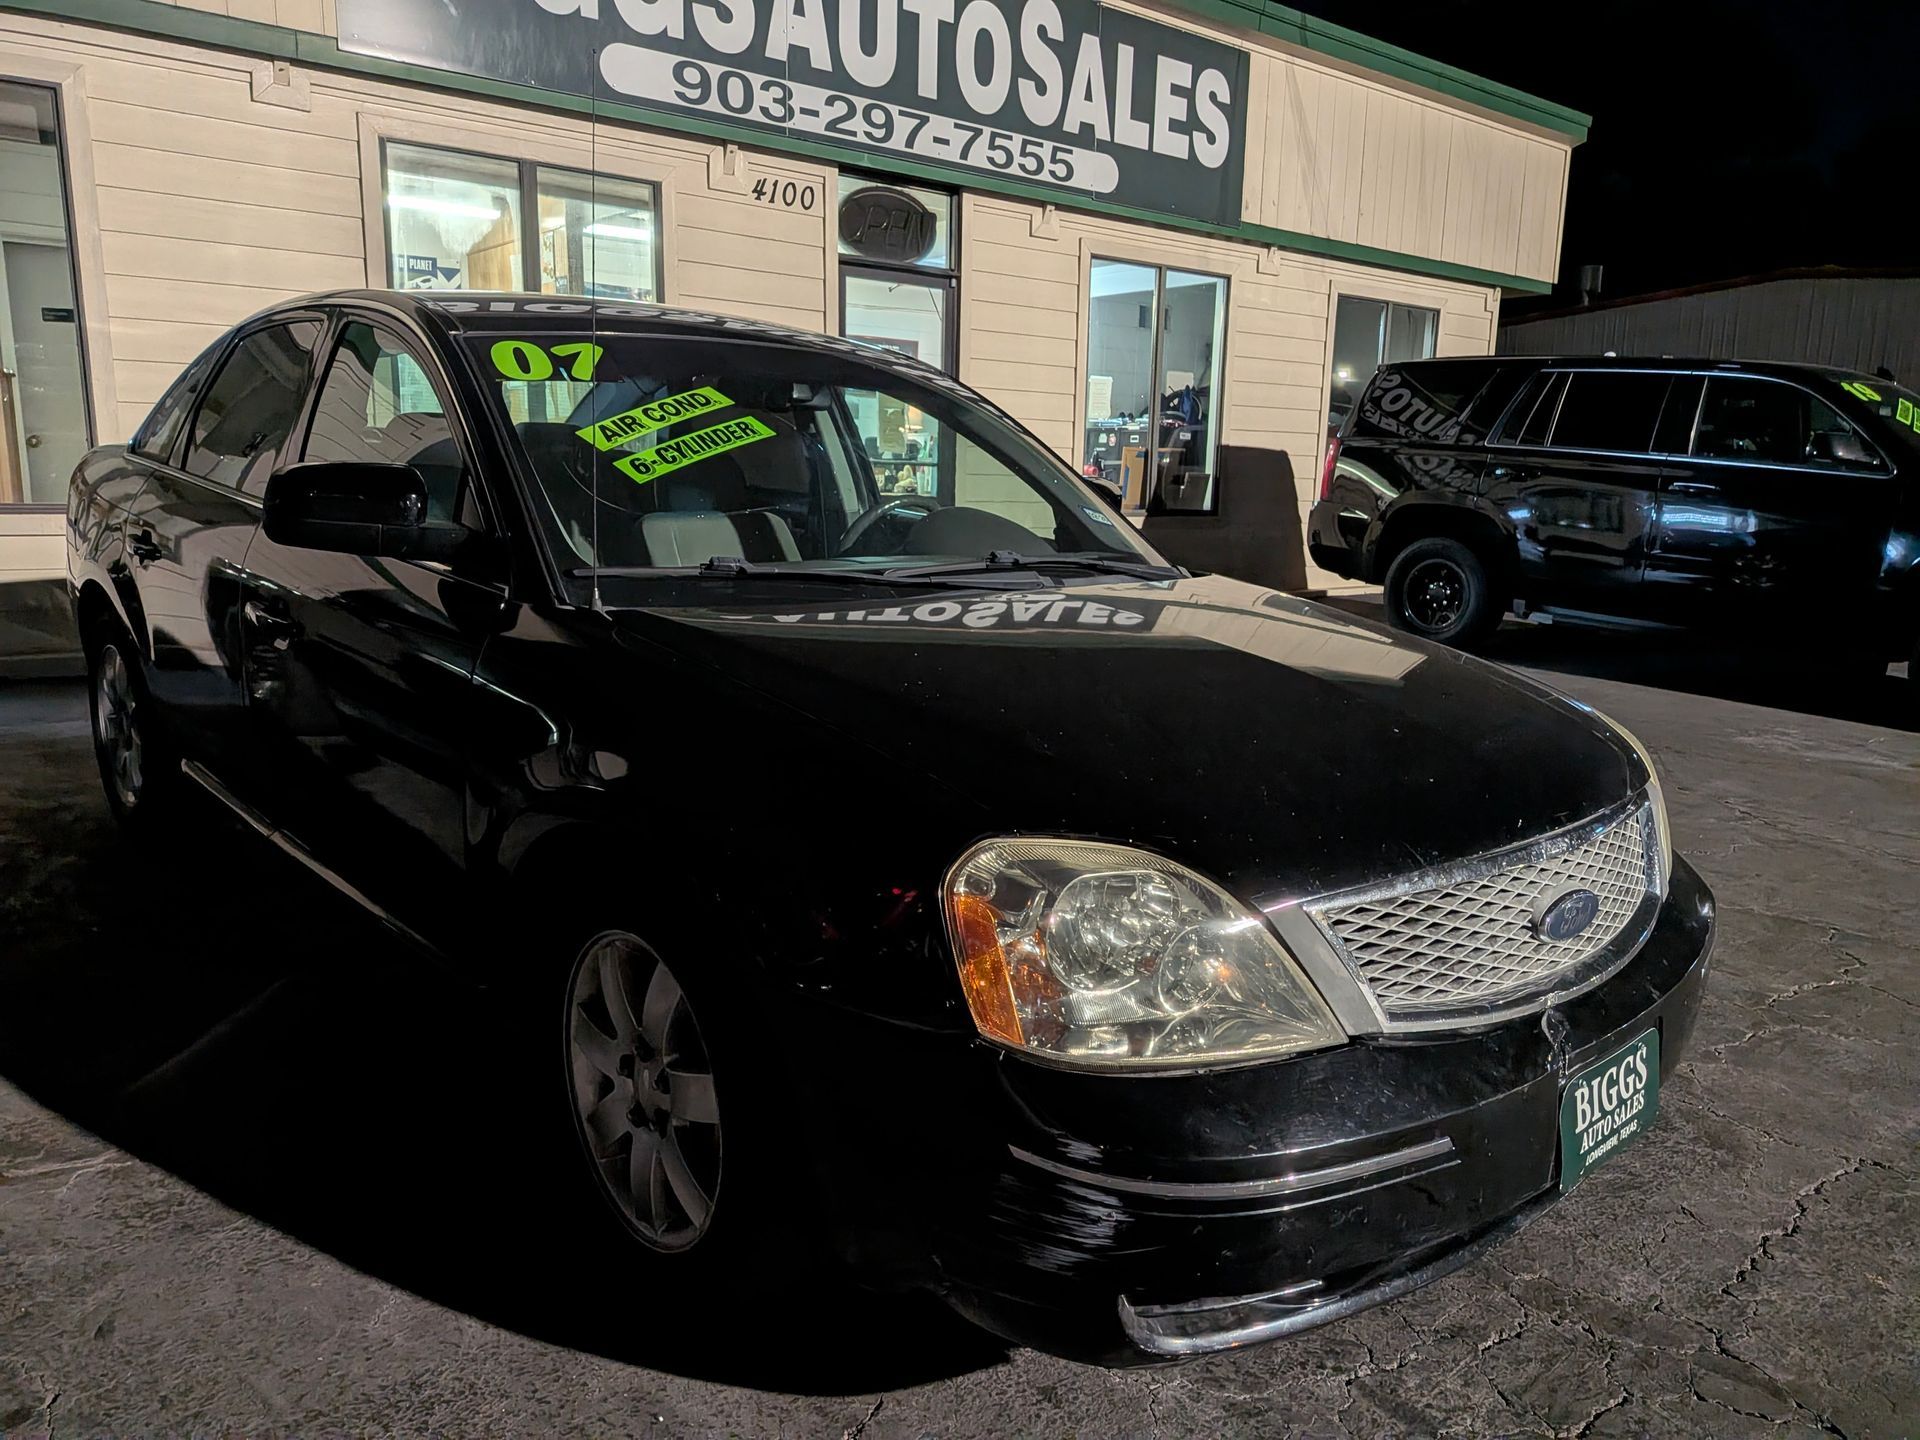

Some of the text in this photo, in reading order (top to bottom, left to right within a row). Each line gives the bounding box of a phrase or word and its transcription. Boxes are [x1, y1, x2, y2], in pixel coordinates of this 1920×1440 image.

[672, 60, 1075, 183] 903-297-7555
[751, 177, 815, 211] 4100
[490, 340, 603, 381] 07
[598, 391, 720, 443] AIR COND.
[628, 420, 758, 477] 6-CYLINDER
[1574, 1045, 1648, 1134] BIGGS
[1580, 1089, 1645, 1154] AUTO SALES
[1620, 1119, 1638, 1141] TEXAS
